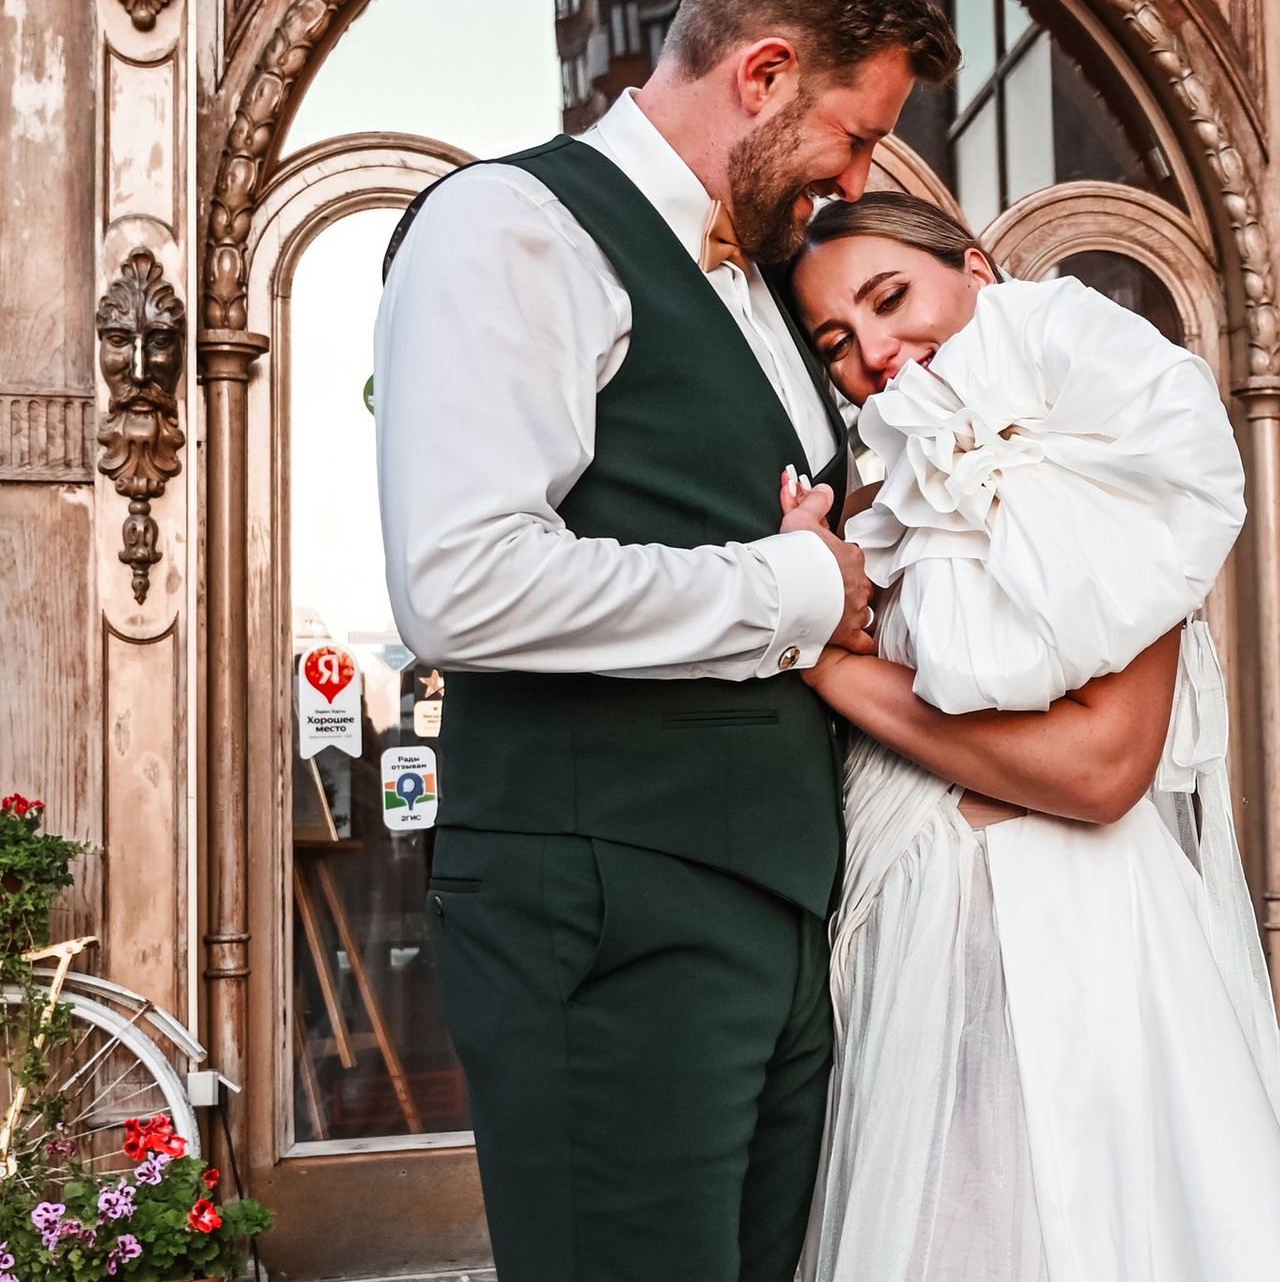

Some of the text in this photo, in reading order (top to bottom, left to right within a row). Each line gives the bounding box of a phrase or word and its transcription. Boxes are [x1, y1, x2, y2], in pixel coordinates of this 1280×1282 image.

[318, 654, 340, 685] Я
[307, 716, 355, 725] Хорошее
[315, 725, 347, 733] место
[397, 755, 420, 763] Рады
[400, 814, 422, 822] 2ГИС
